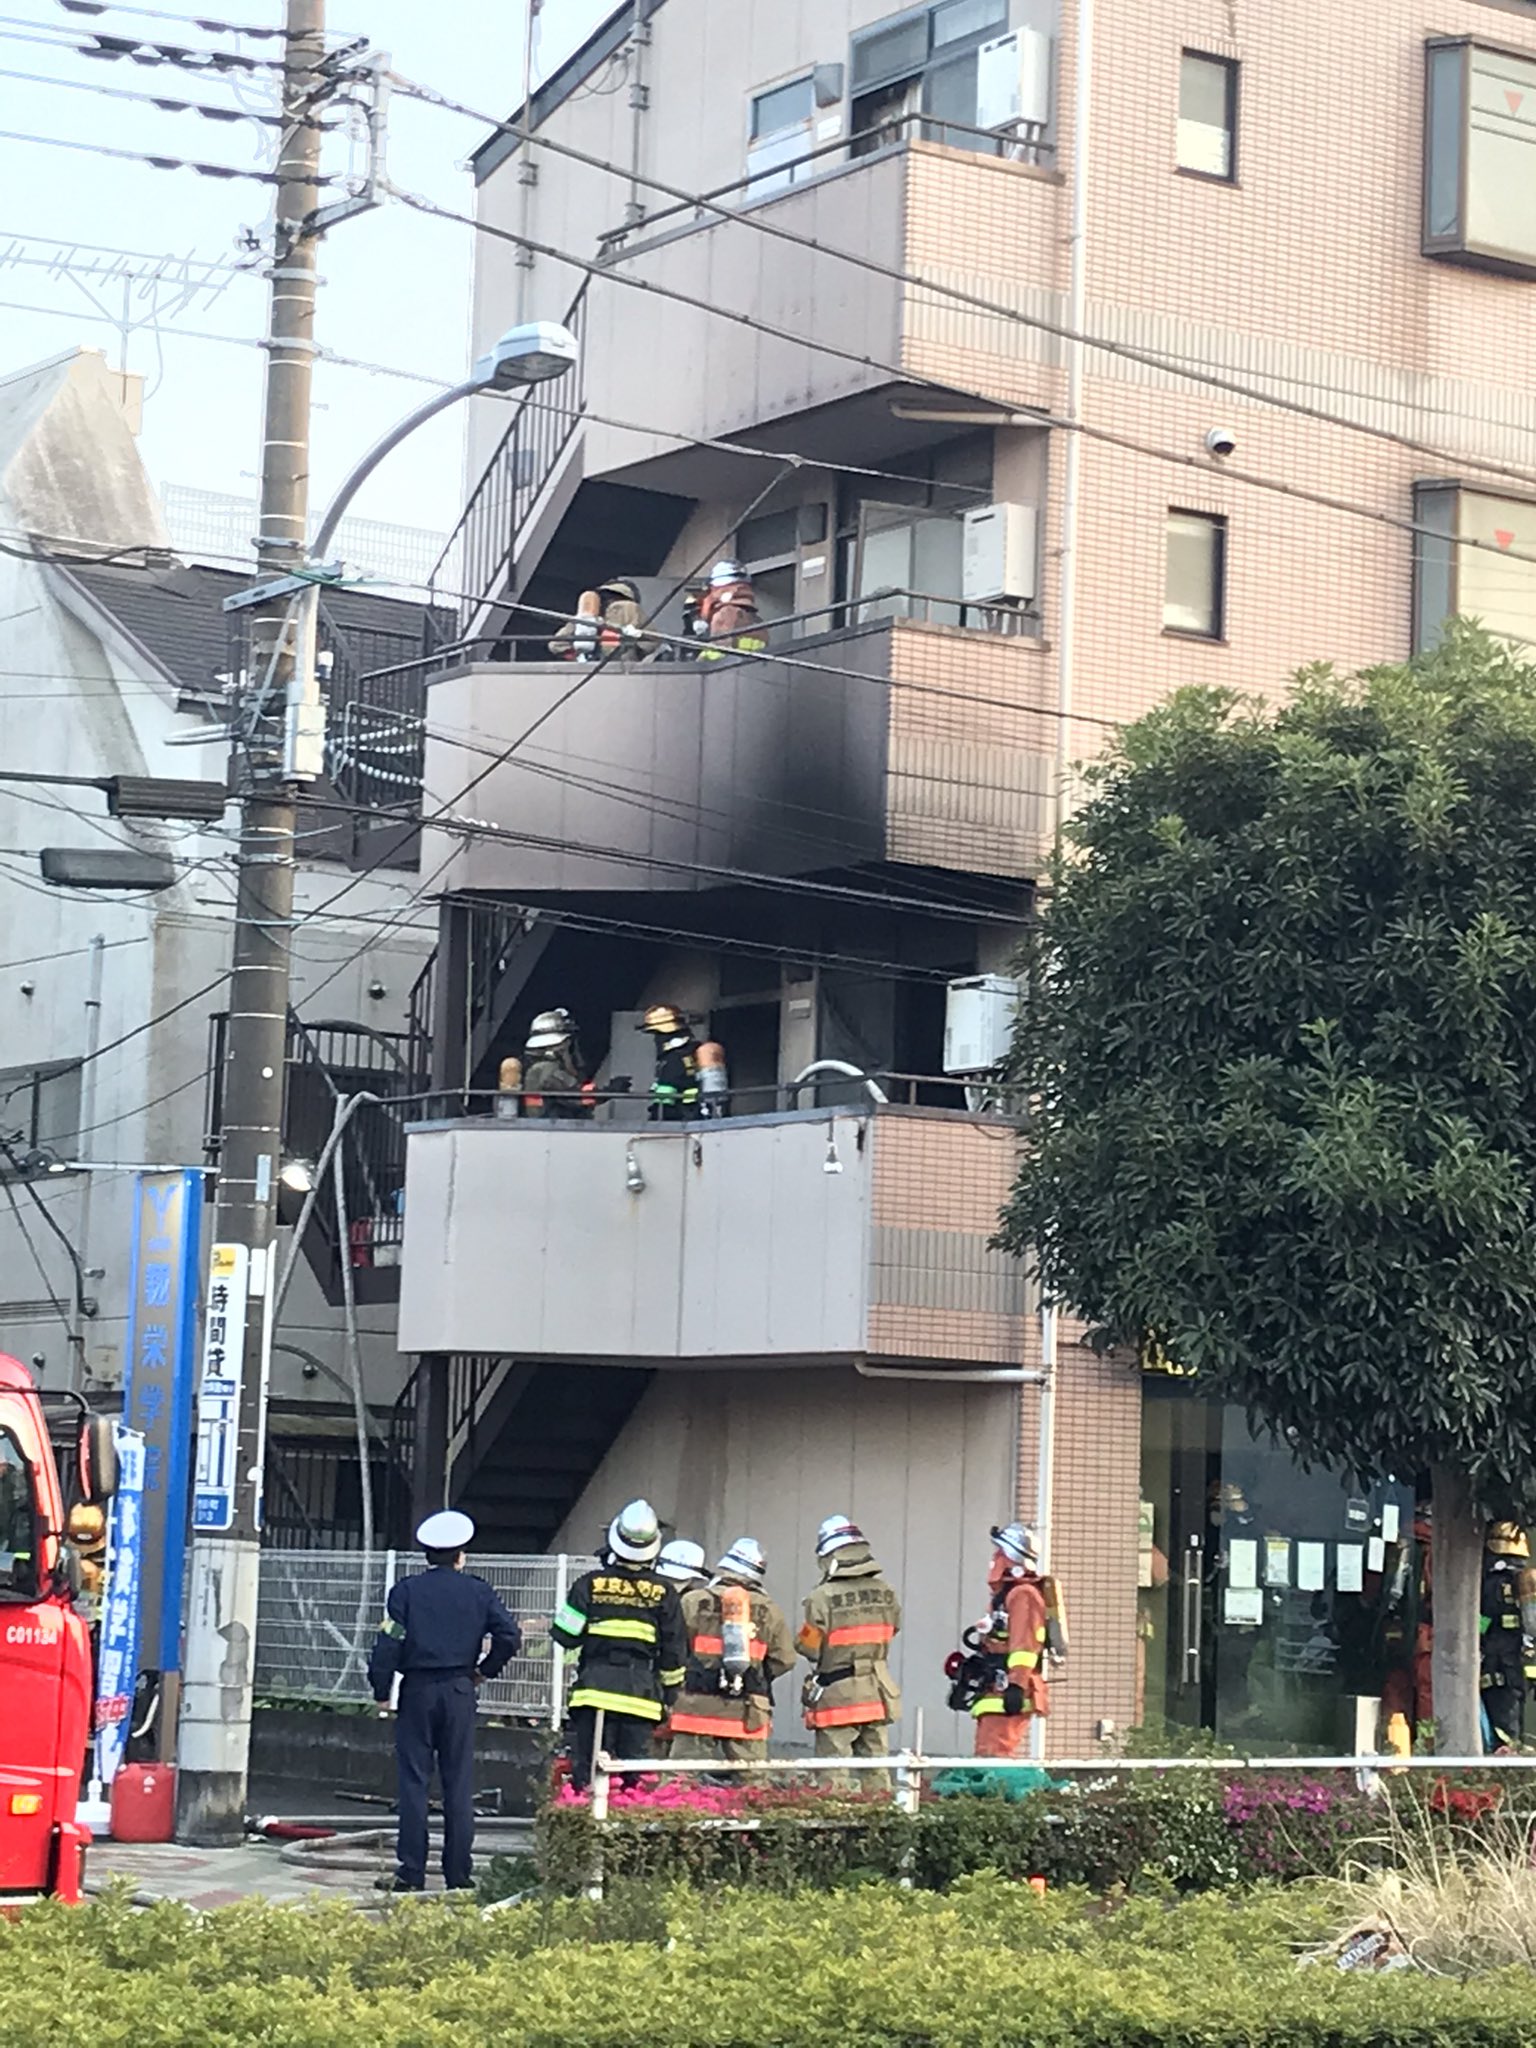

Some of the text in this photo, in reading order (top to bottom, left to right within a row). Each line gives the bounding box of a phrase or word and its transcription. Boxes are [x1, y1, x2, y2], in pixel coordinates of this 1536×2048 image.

[206, 1284, 229, 1377] 時間貸
[6, 1625, 57, 1645] C01134
